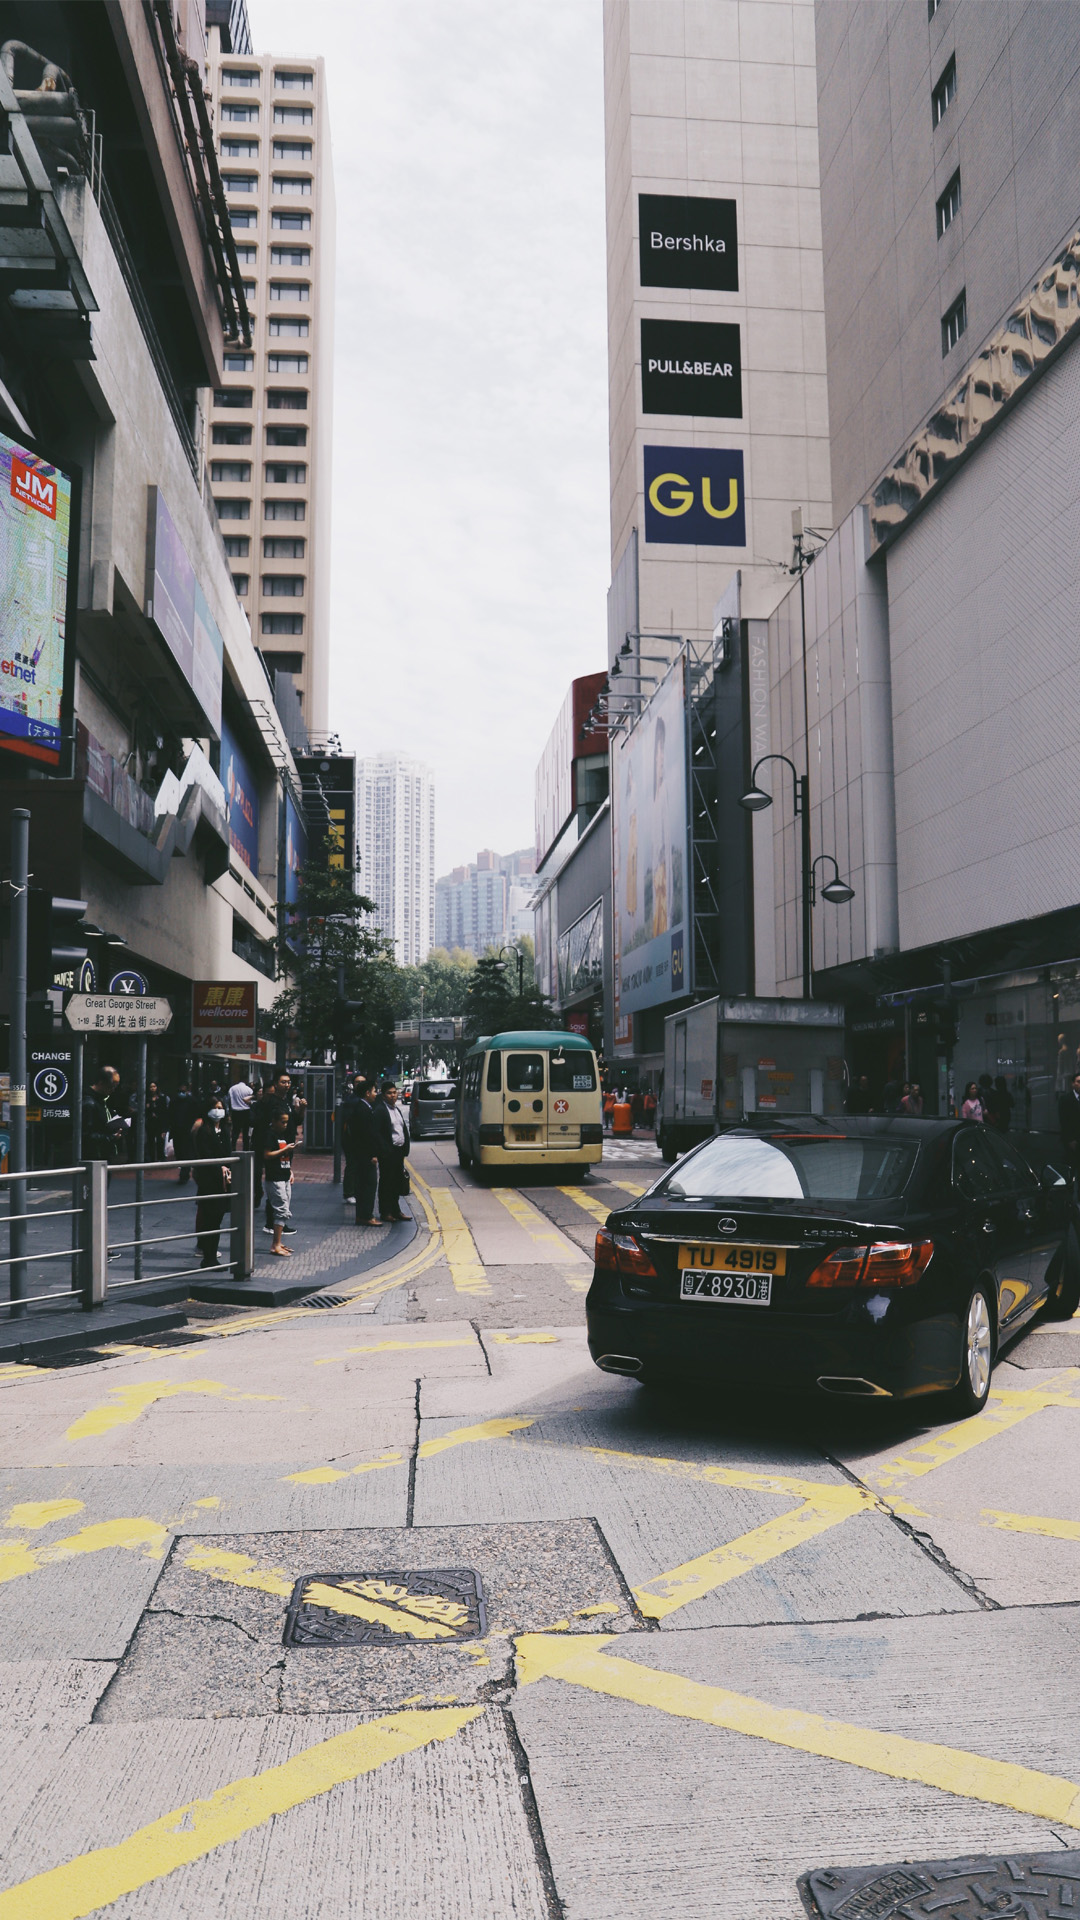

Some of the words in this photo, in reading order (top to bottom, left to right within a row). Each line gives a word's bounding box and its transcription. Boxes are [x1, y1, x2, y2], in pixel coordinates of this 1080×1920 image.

[650, 231, 726, 253] Bershka
[648, 359, 733, 377] PULL&BEAR
[16, 470, 54, 505] JM
[648, 472, 739, 519] GU
[15, 487, 53, 513] NETWORK
[1, 660, 37, 685] etnet
[751, 636, 768, 717] FASHION
[671, 947, 684, 976] GU
[85, 997, 107, 1009] Great
[108, 998, 134, 1011] George
[135, 999, 157, 1010] Street
[203, 987, 246, 1006] 惠康
[94, 1013, 147, 1029] 記利佐治街
[199, 1006, 249, 1017] wellcome
[192, 1034, 214, 1049] 24
[31, 1052, 71, 1061] CHANGE
[44, 1072, 58, 1097] $
[687, 1246, 715, 1267] TU
[724, 1248, 777, 1271] 4919
